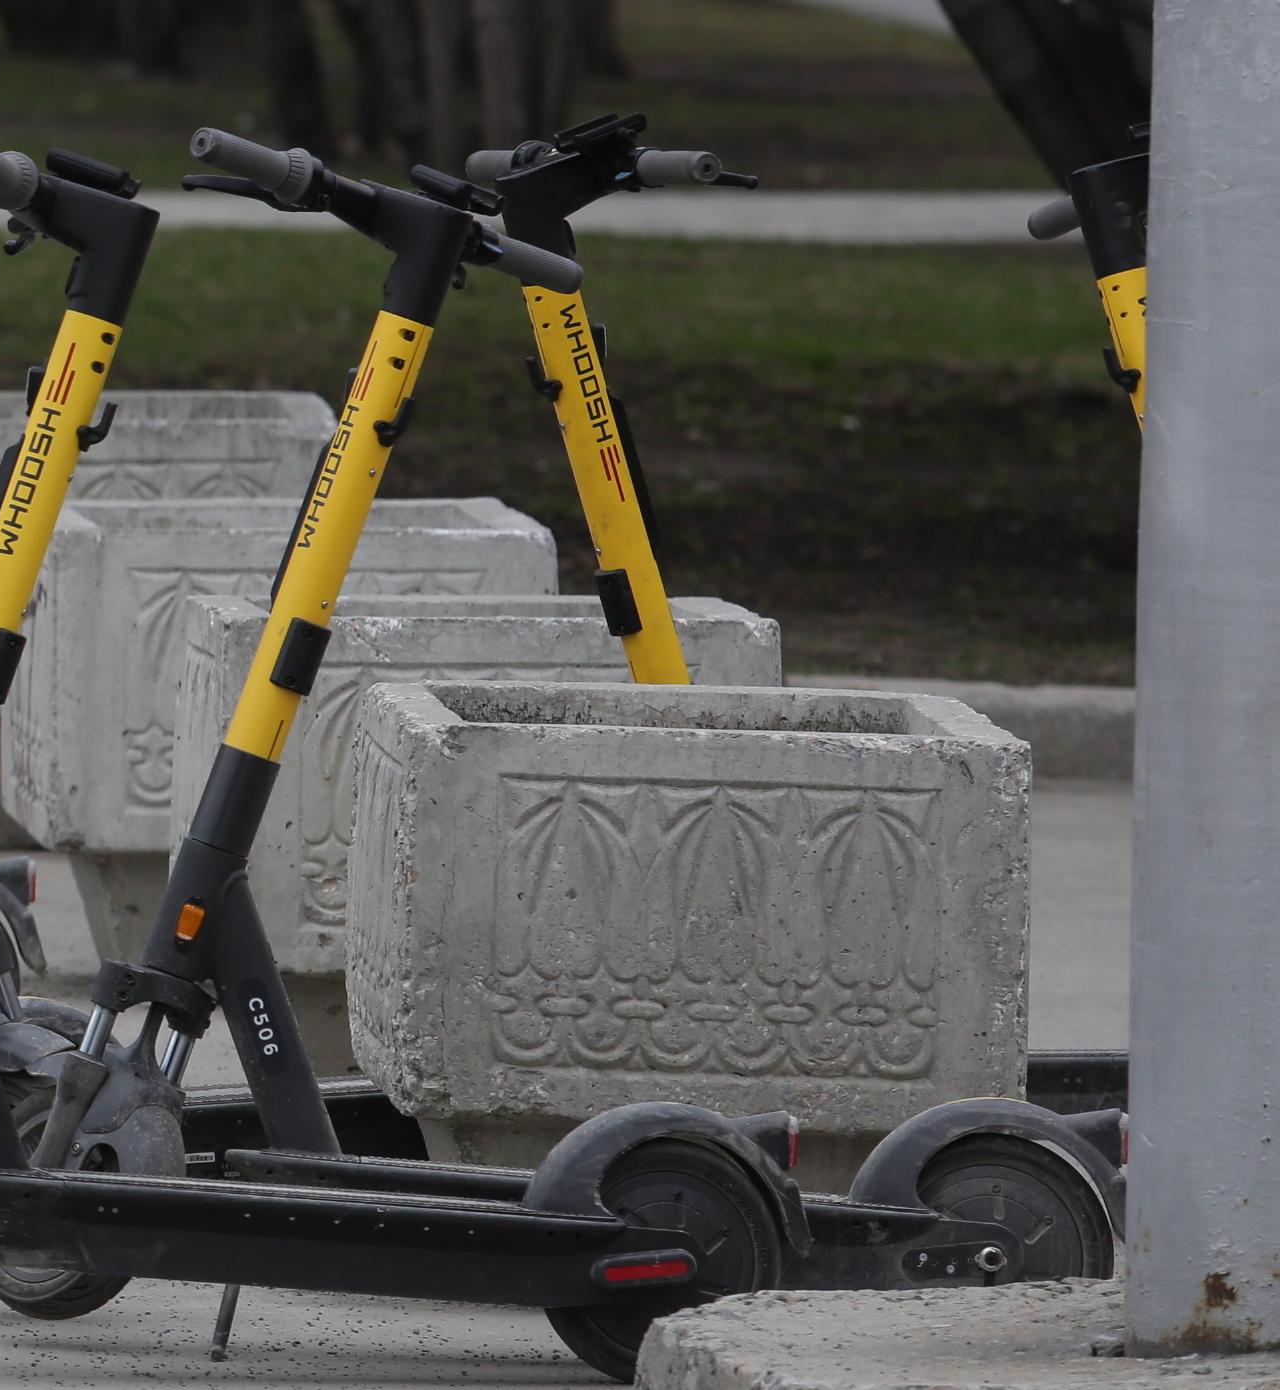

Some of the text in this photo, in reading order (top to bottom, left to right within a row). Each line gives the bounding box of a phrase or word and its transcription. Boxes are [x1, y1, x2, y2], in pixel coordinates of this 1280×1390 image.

[559, 303, 613, 443] WHOOSH
[297, 404, 360, 549] WHOOSH
[248, 997, 279, 1056] C506
